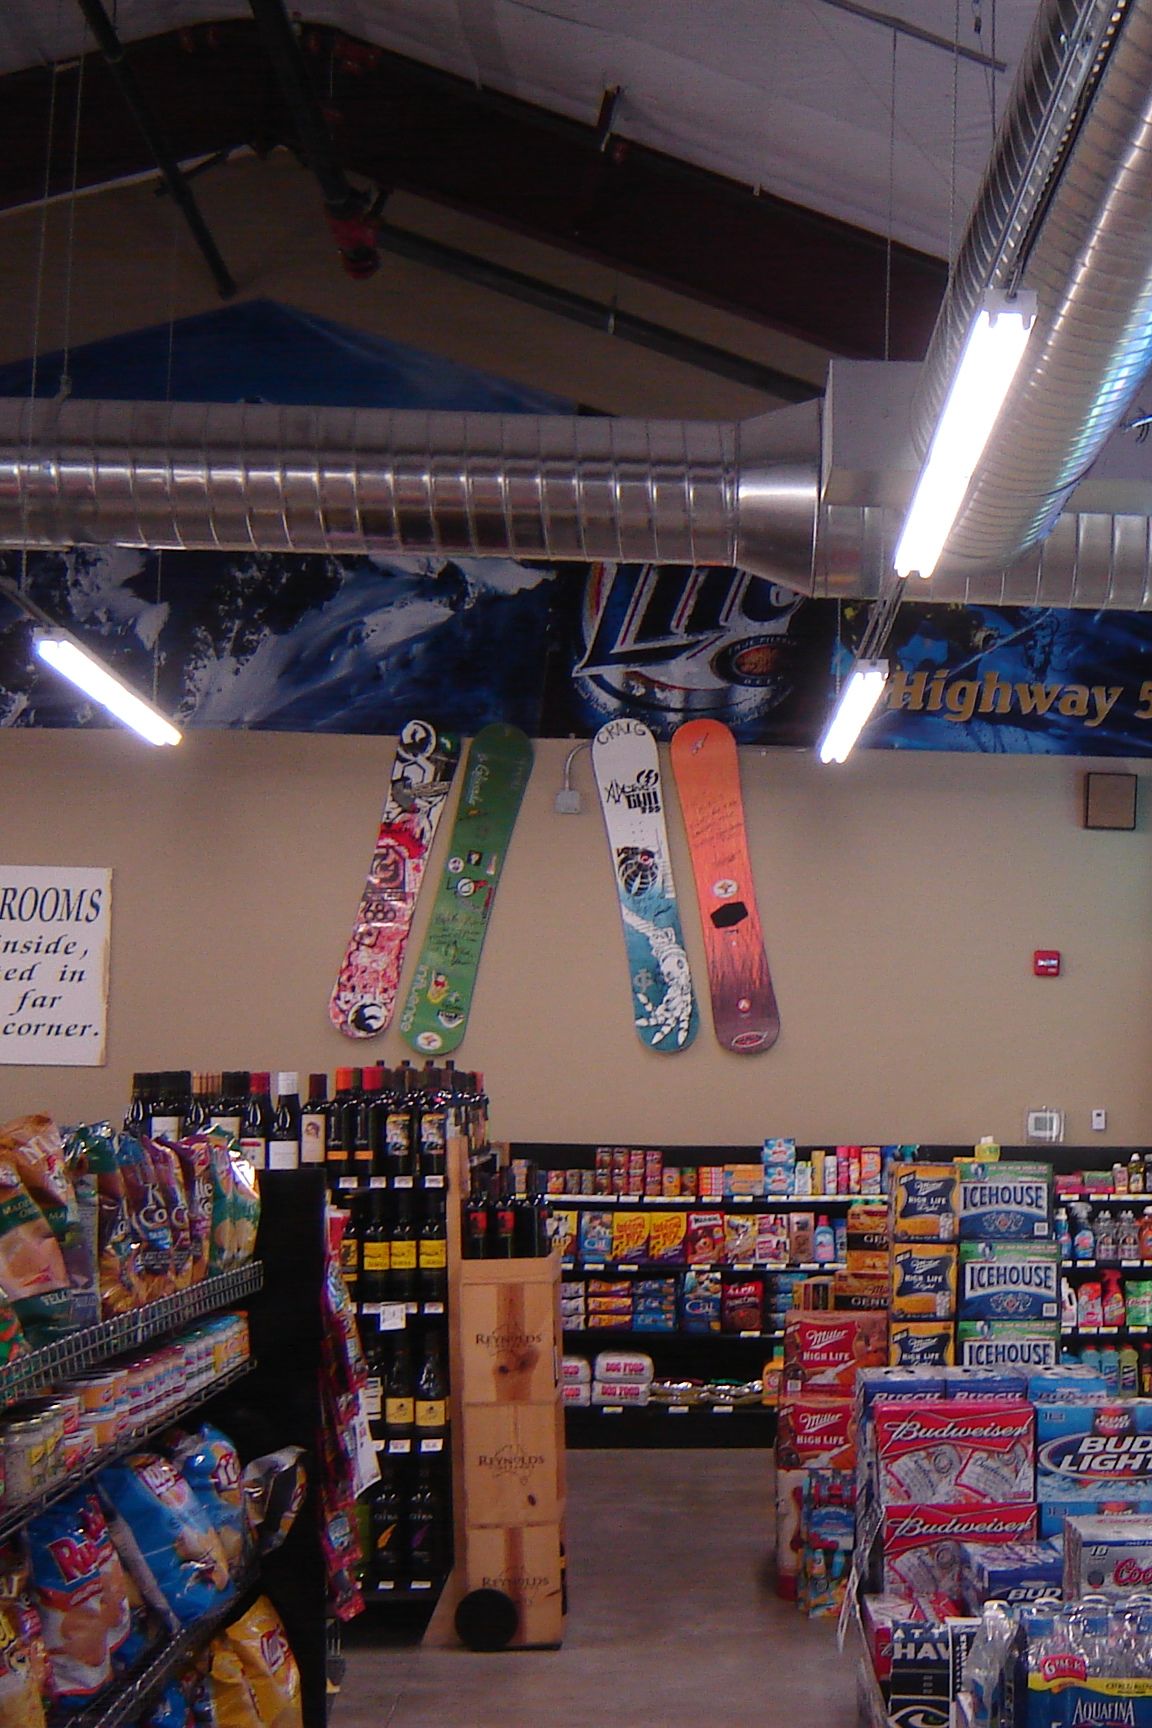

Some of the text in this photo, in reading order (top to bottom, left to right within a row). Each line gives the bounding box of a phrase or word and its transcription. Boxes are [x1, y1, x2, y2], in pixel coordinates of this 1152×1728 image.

[888, 672, 1124, 727] Highway
[597, 722, 647, 745] CRAIG
[0, 887, 103, 923] ROOMS
[0, 934, 89, 960] nside,
[58, 964, 87, 982] in
[8, 989, 62, 1016] far
[3, 1022, 100, 1037] corner.
[930, 1196, 947, 1205] LIFE
[962, 1186, 1043, 1211] ICEHOUSE
[926, 1274, 943, 1283] LIFE
[970, 1266, 1052, 1291] ICEHOUSE
[475, 1333, 542, 1347] REYNOLDS
[805, 1329, 848, 1350] Miller
[802, 1351, 850, 1362] HIGH LIFE
[923, 1351, 940, 1360] LIFE
[968, 1343, 1050, 1366] ICEHOUSE
[799, 1413, 842, 1433] Miller
[884, 1421, 1028, 1441] Budweiser
[796, 1435, 845, 1445] HIGH LIFE
[478, 1455, 545, 1467] REYNOLDS
[887, 1517, 1032, 1537] Budweiser
[482, 1576, 549, 1588] REYNOLDS
[1007, 1588, 1063, 1600] BUD
[1072, 1696, 1135, 1727] AQUAFINA
